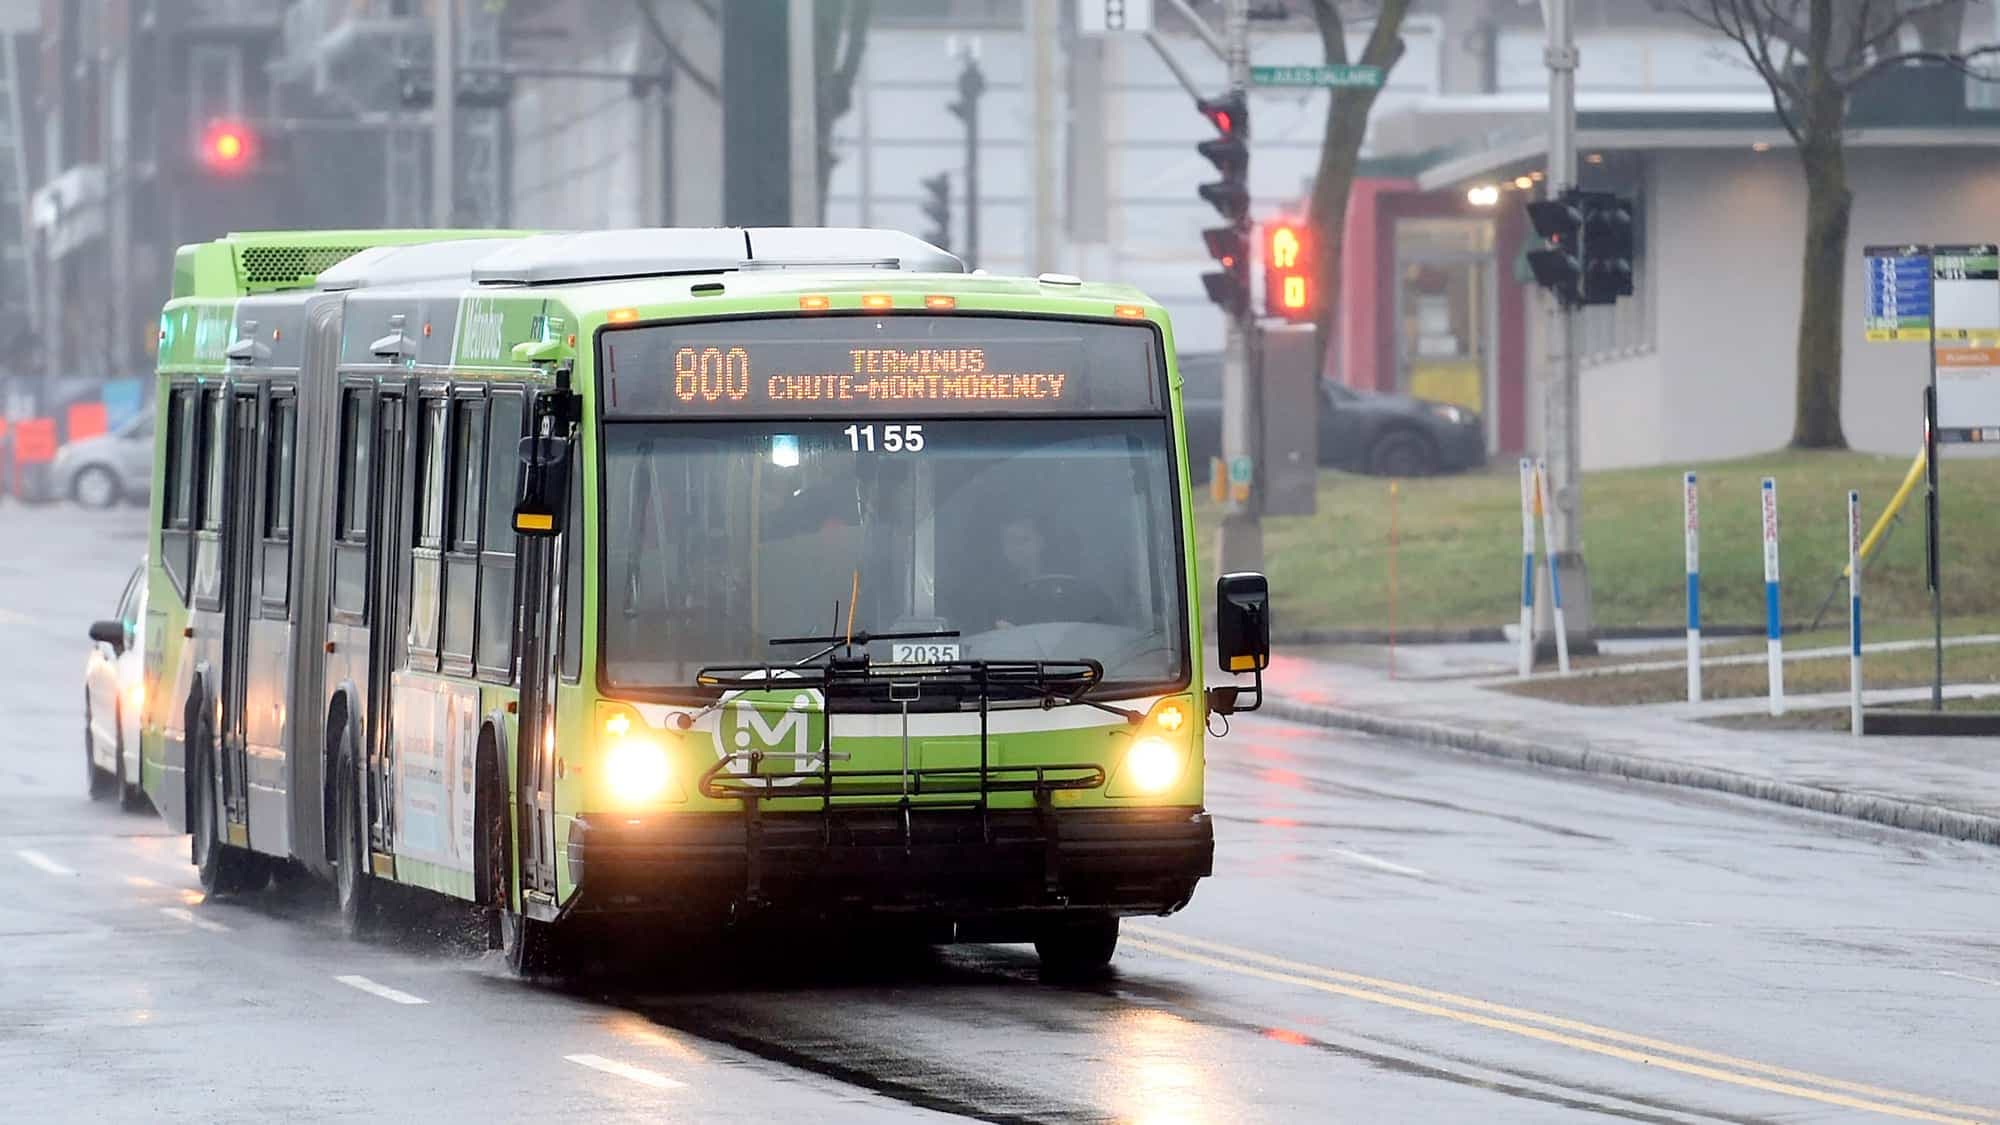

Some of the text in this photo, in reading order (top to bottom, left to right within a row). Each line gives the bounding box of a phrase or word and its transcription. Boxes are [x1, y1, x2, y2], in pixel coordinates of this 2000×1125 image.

[849, 349, 985, 373] TERMINUS
[675, 347, 749, 401] 800
[767, 373, 1066, 399] CHUTE-MONTMORENCY
[901, 646, 954, 663] 2035
